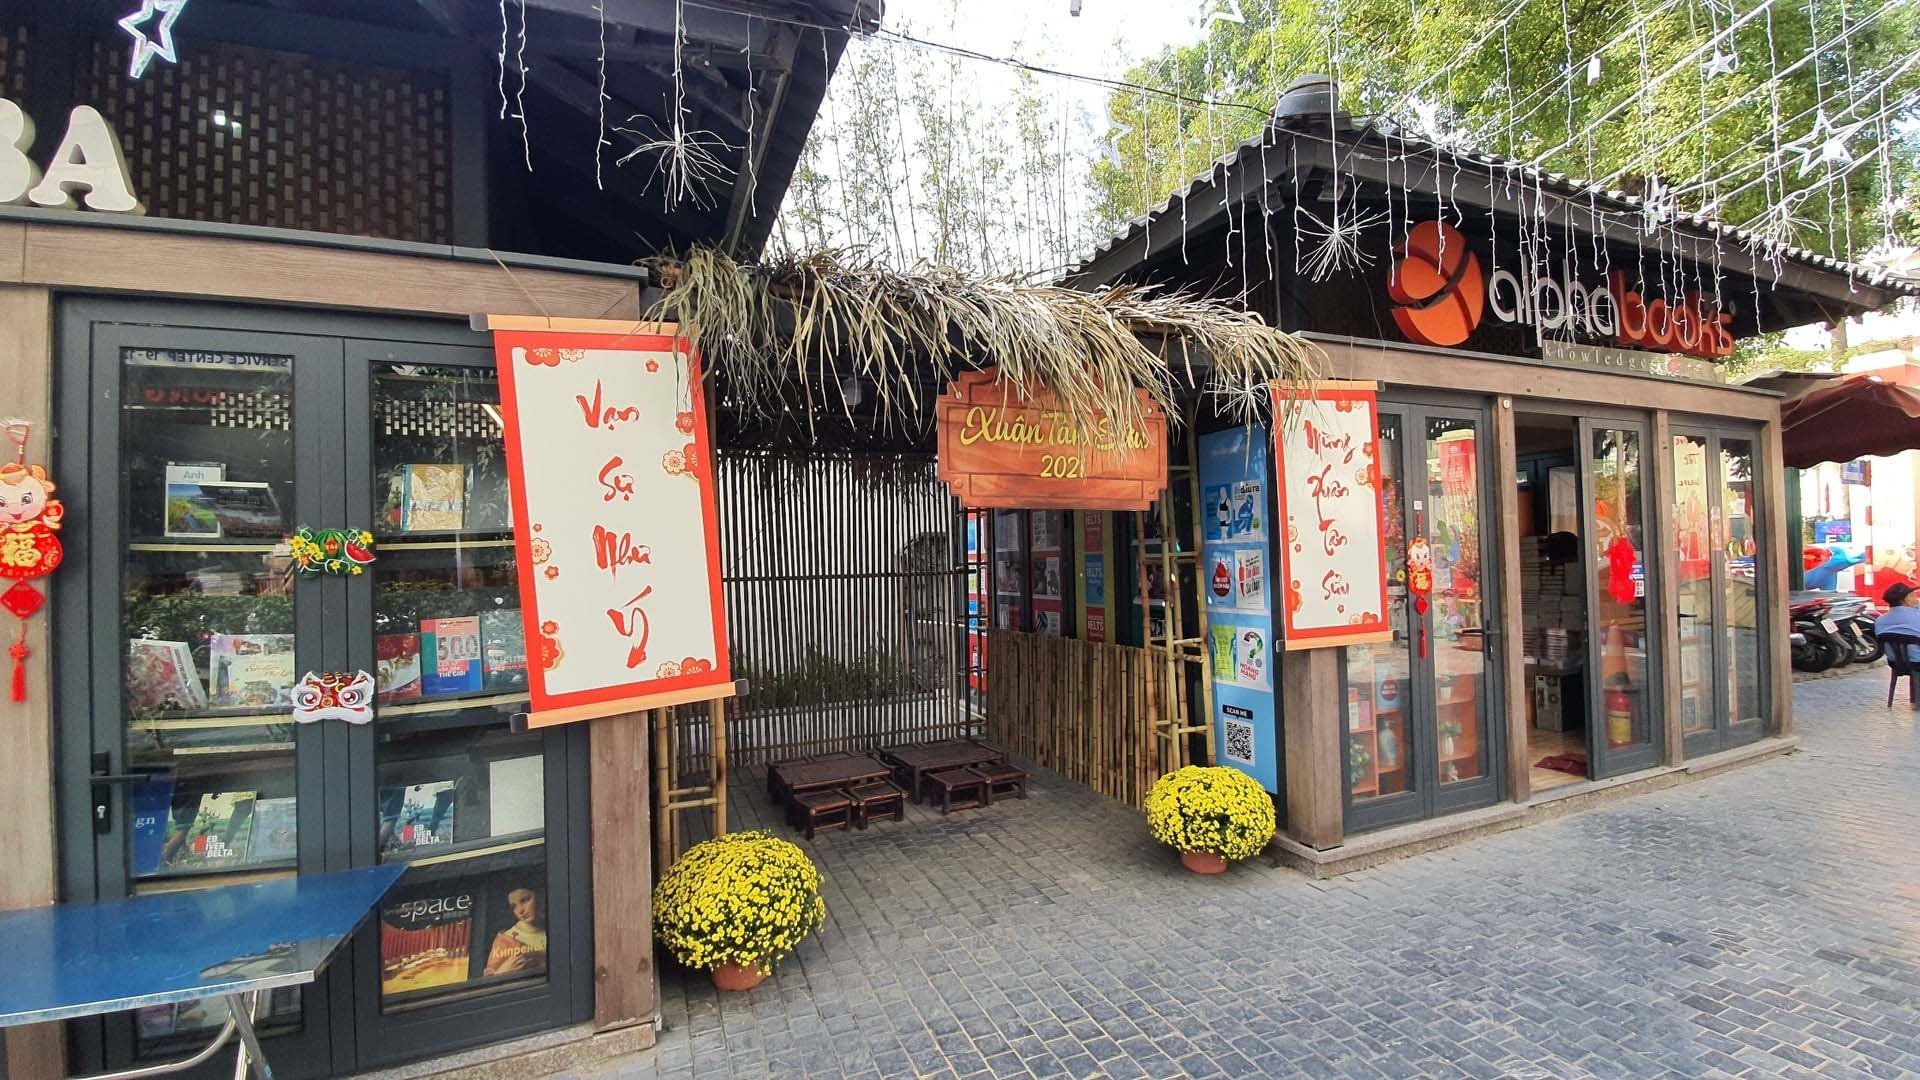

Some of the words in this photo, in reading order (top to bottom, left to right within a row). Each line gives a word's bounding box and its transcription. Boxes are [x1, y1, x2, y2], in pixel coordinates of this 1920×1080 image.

[576, 378, 640, 431] Vạn
[960, 405, 1044, 446] Xuân
[1304, 419, 1356, 464] Mừng
[598, 455, 634, 502] Sự
[1307, 464, 1350, 515] Xuân
[1, 533, 42, 567] 福
[592, 524, 652, 583] Như
[1319, 519, 1347, 556] Tân
[1321, 569, 1350, 601] Sửu
[438, 634, 478, 660] 500
[400, 893, 471, 922] space
